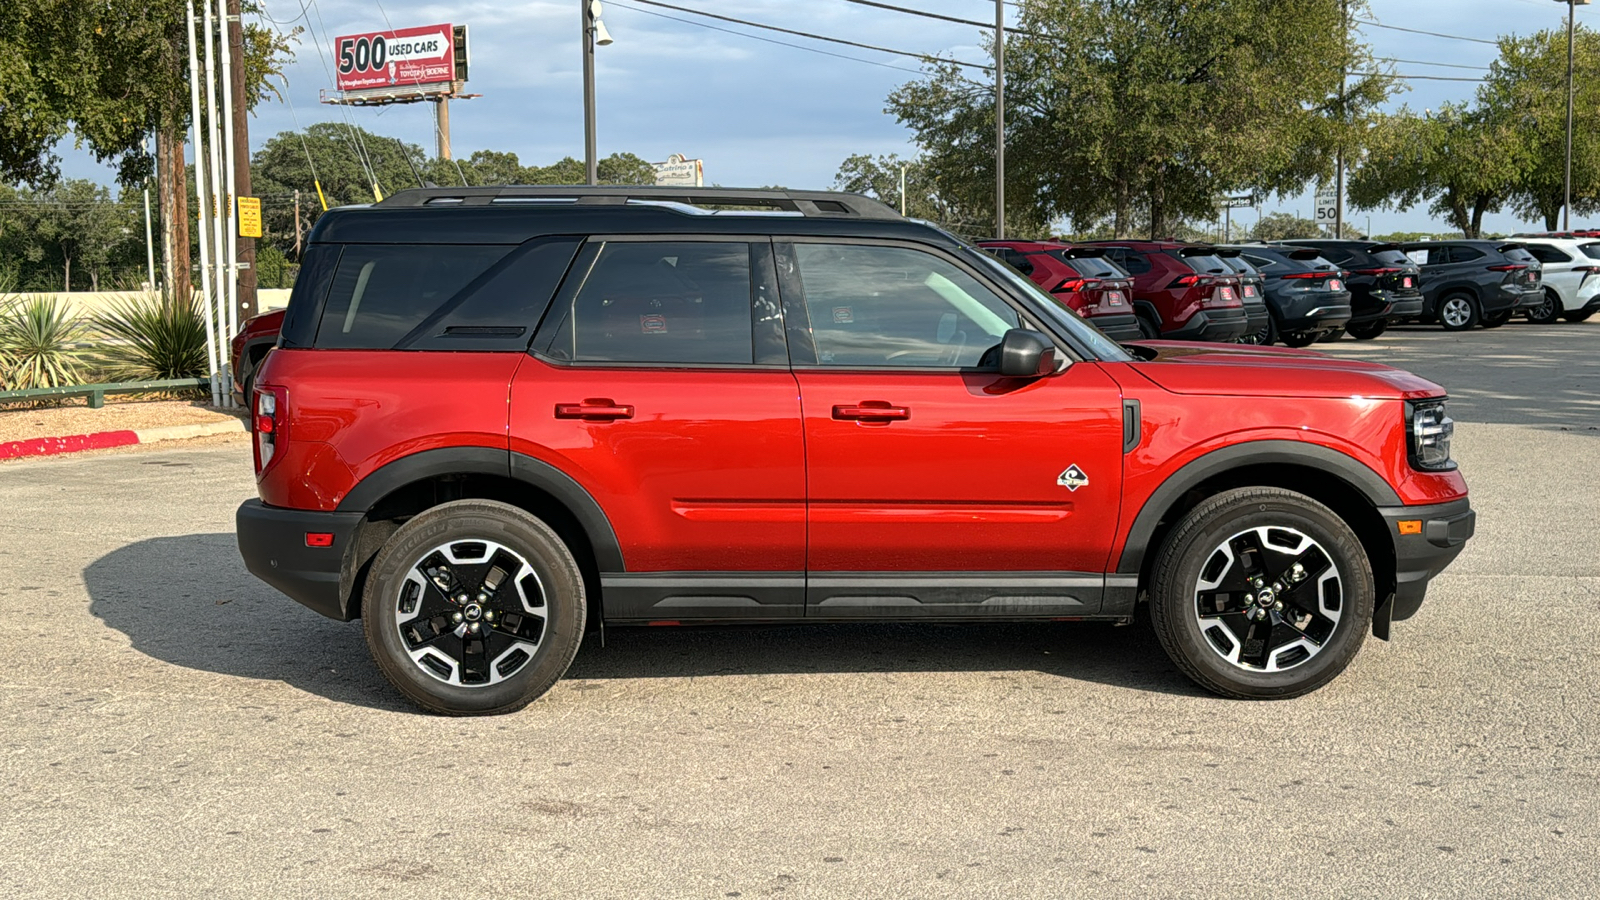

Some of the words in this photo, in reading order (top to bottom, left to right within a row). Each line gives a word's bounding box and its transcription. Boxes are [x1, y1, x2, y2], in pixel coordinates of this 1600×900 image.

[339, 36, 386, 73] 500
[389, 43, 413, 56] USED
[414, 40, 438, 54] CARS
[1317, 207, 1337, 219] 50
